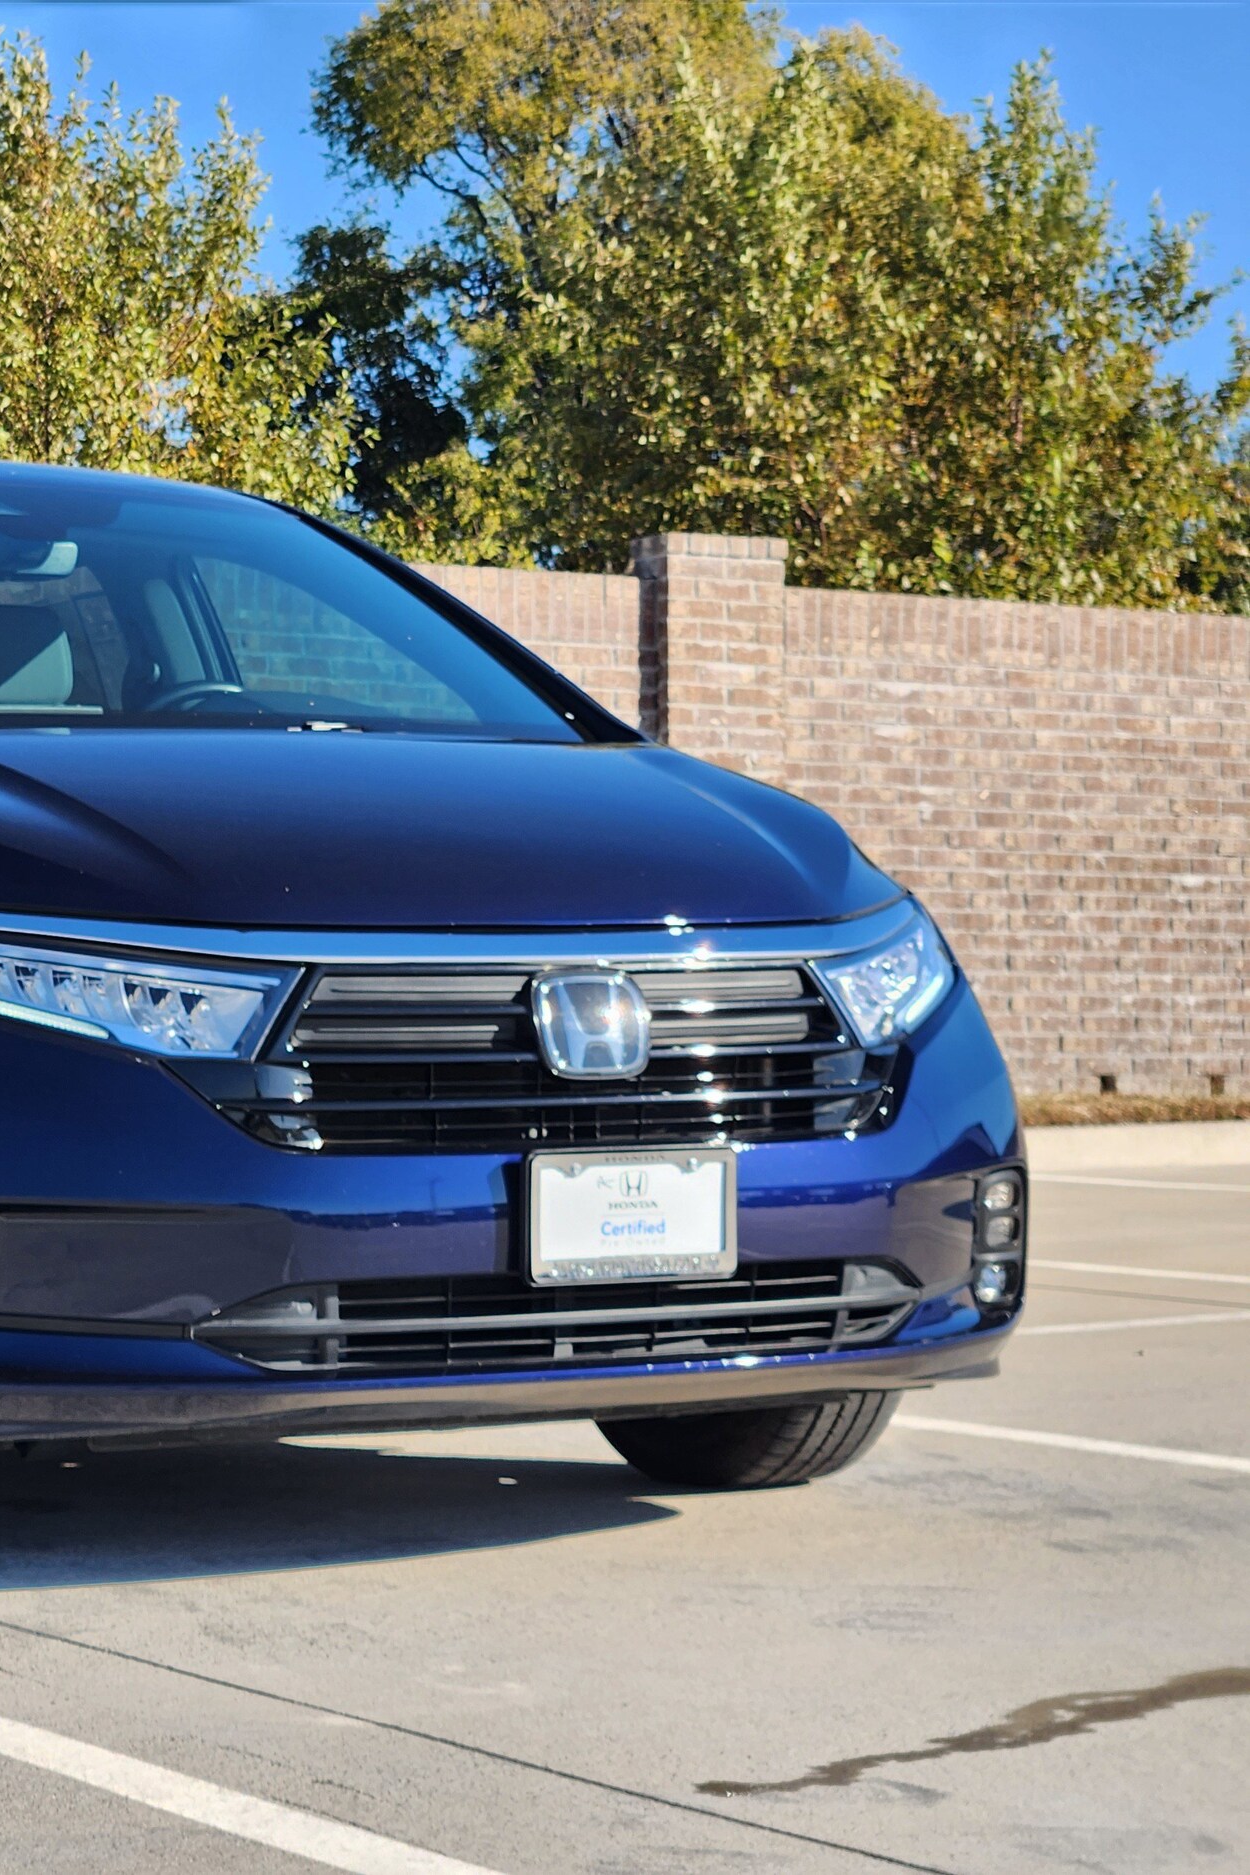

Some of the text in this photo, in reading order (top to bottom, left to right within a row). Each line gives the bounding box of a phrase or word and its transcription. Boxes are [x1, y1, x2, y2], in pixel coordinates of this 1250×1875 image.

[605, 1155, 665, 1163] HONDA
[608, 1200, 658, 1210] HONDA
[600, 1217, 667, 1236] Certified
